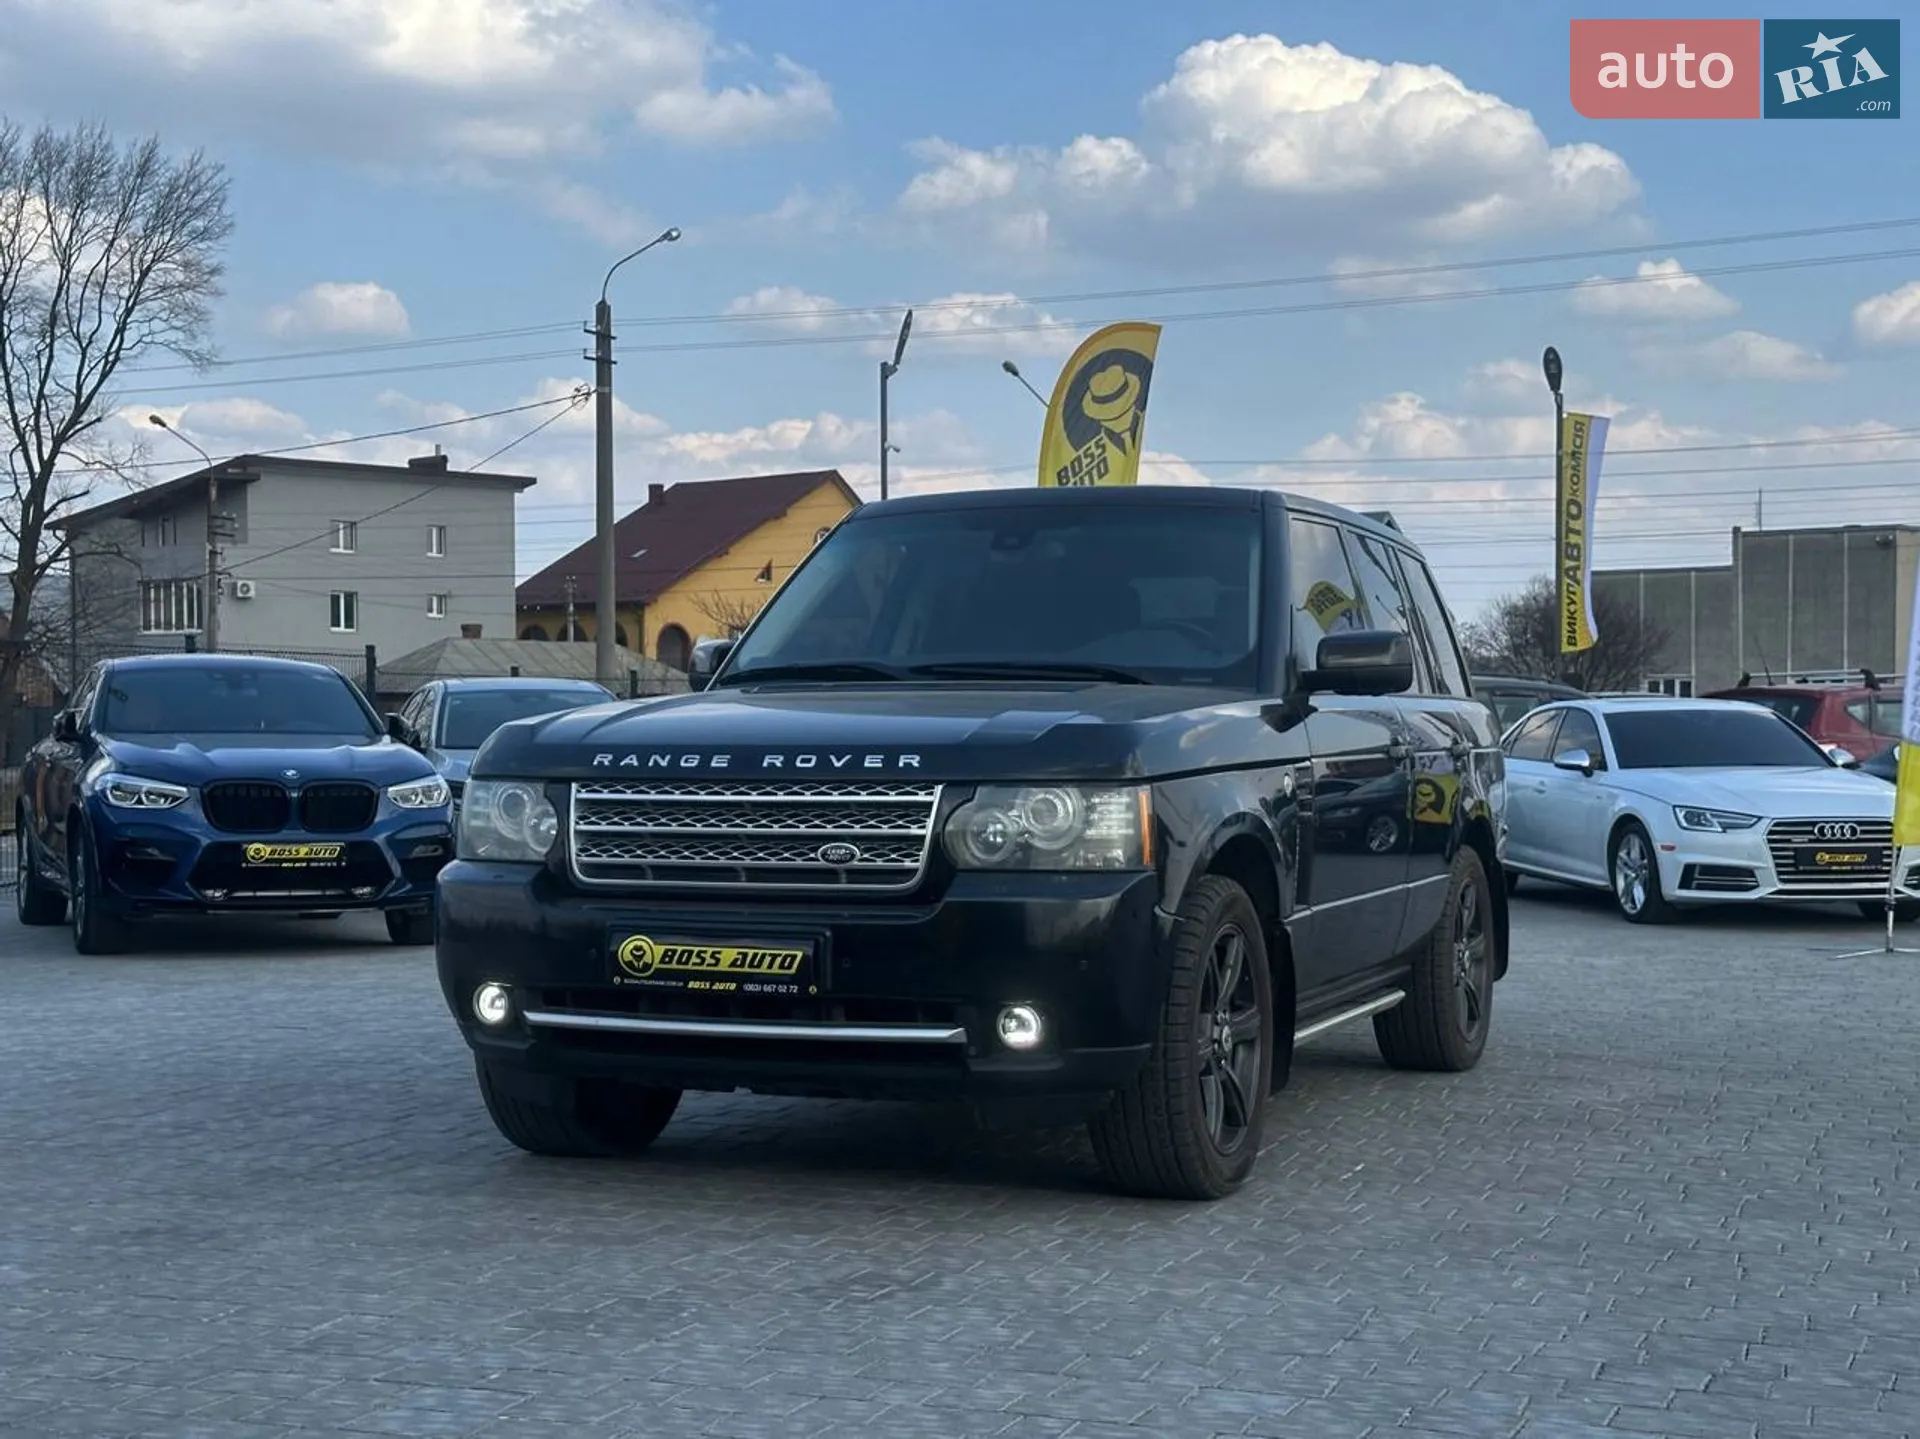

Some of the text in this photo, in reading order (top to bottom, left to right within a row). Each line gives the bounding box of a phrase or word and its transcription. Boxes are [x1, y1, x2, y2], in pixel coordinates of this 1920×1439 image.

[1056, 436, 1106, 486] BOSS
[1564, 499, 1583, 586] АВТО
[593, 753, 921, 768] RANGE ROVER
[268, 847, 338, 856] BOSS AUTO
[658, 948, 798, 970] BOSS AUTO
[687, 980, 710, 989] BOSS
[711, 981, 737, 990] AUTO
